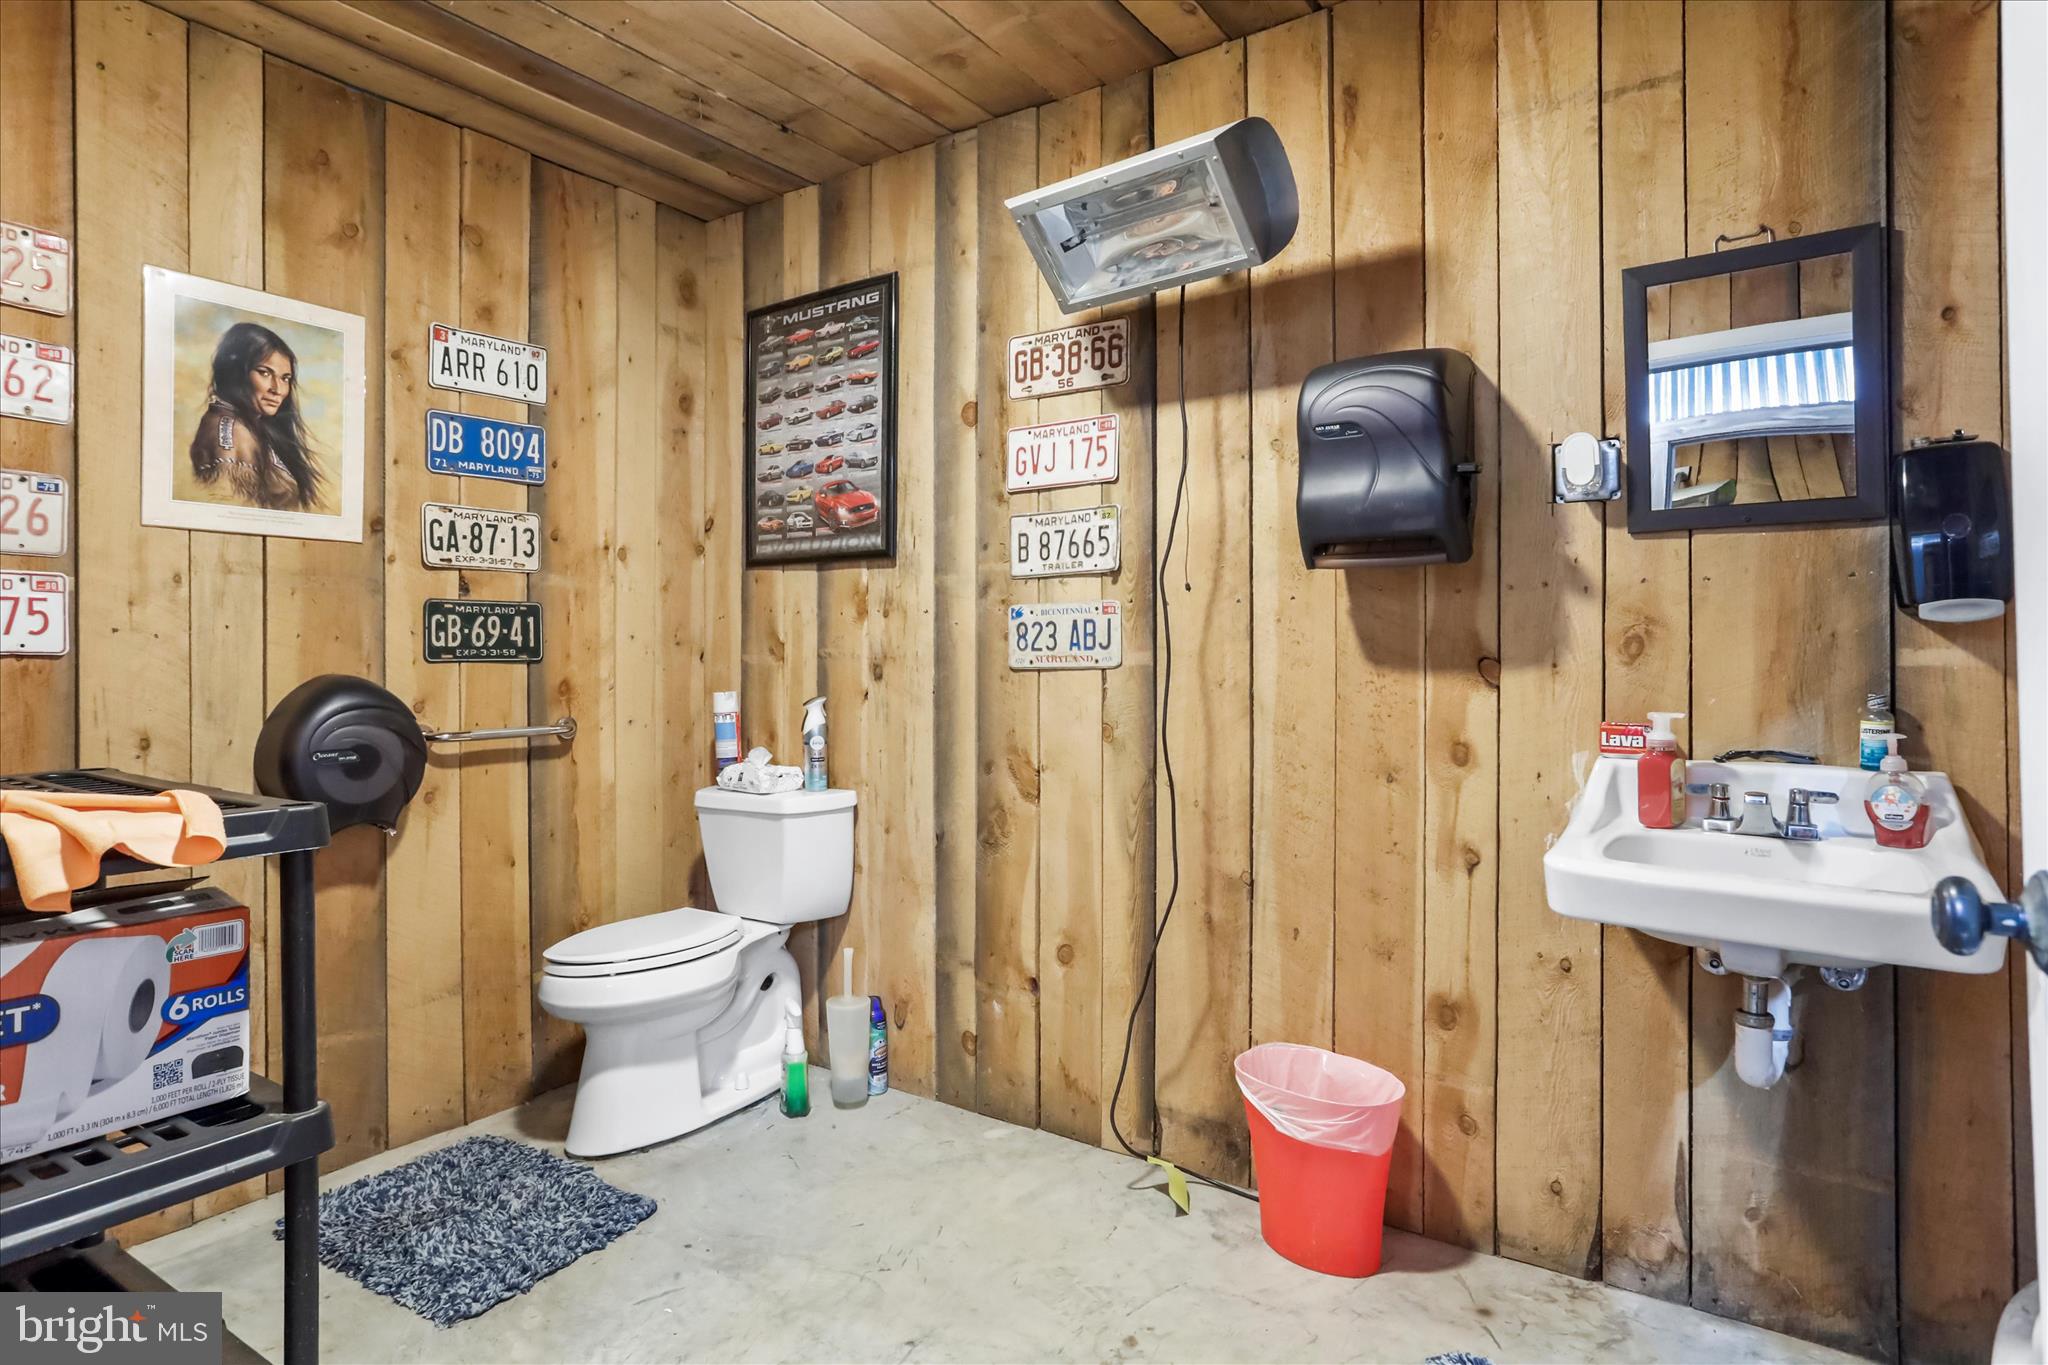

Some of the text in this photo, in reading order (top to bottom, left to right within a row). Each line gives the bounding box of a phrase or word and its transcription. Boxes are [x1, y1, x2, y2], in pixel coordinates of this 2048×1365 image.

[2, 245, 52, 292] 25
[783, 291, 880, 326] MUSTANG
[439, 330, 446, 340] 3
[1034, 326, 1100, 346] MARYLAND
[460, 335, 521, 356] MARYLAND
[440, 346, 538, 392] ARR 610
[4, 358, 53, 403] 62
[1058, 377, 1074, 388] 56
[1034, 424, 1090, 440] MARYLAND
[432, 418, 540, 464] DB 8094
[1016, 435, 1108, 476] GVJ 175
[434, 457, 519, 475] 71 MARYLAND
[0, 495, 49, 536] 26
[453, 511, 514, 524] MARYLAND
[1035, 513, 1091, 527] MARYLAND
[1018, 525, 1110, 563] B 87665
[1042, 561, 1084, 571] TRAILER
[0, 596, 49, 636] 75
[455, 606, 516, 615] MARYLAND
[1040, 607, 1092, 616] BICENTENNIAL
[1016, 618, 1112, 652] 823 ABJ
[1034, 655, 1094, 664] MARYLAND
[1601, 731, 1644, 748] Lava
[174, 948, 194, 956] SCAN
[174, 954, 194, 962] HERE
[169, 988, 245, 1020] 6 ROLLS
[168, 1089, 181, 1099] FEET
[182, 1086, 193, 1095] PER
[193, 1082, 208, 1092] ROLL
[178, 1094, 195, 1104] TOTAL
[196, 1089, 219, 1100] LENGTH
